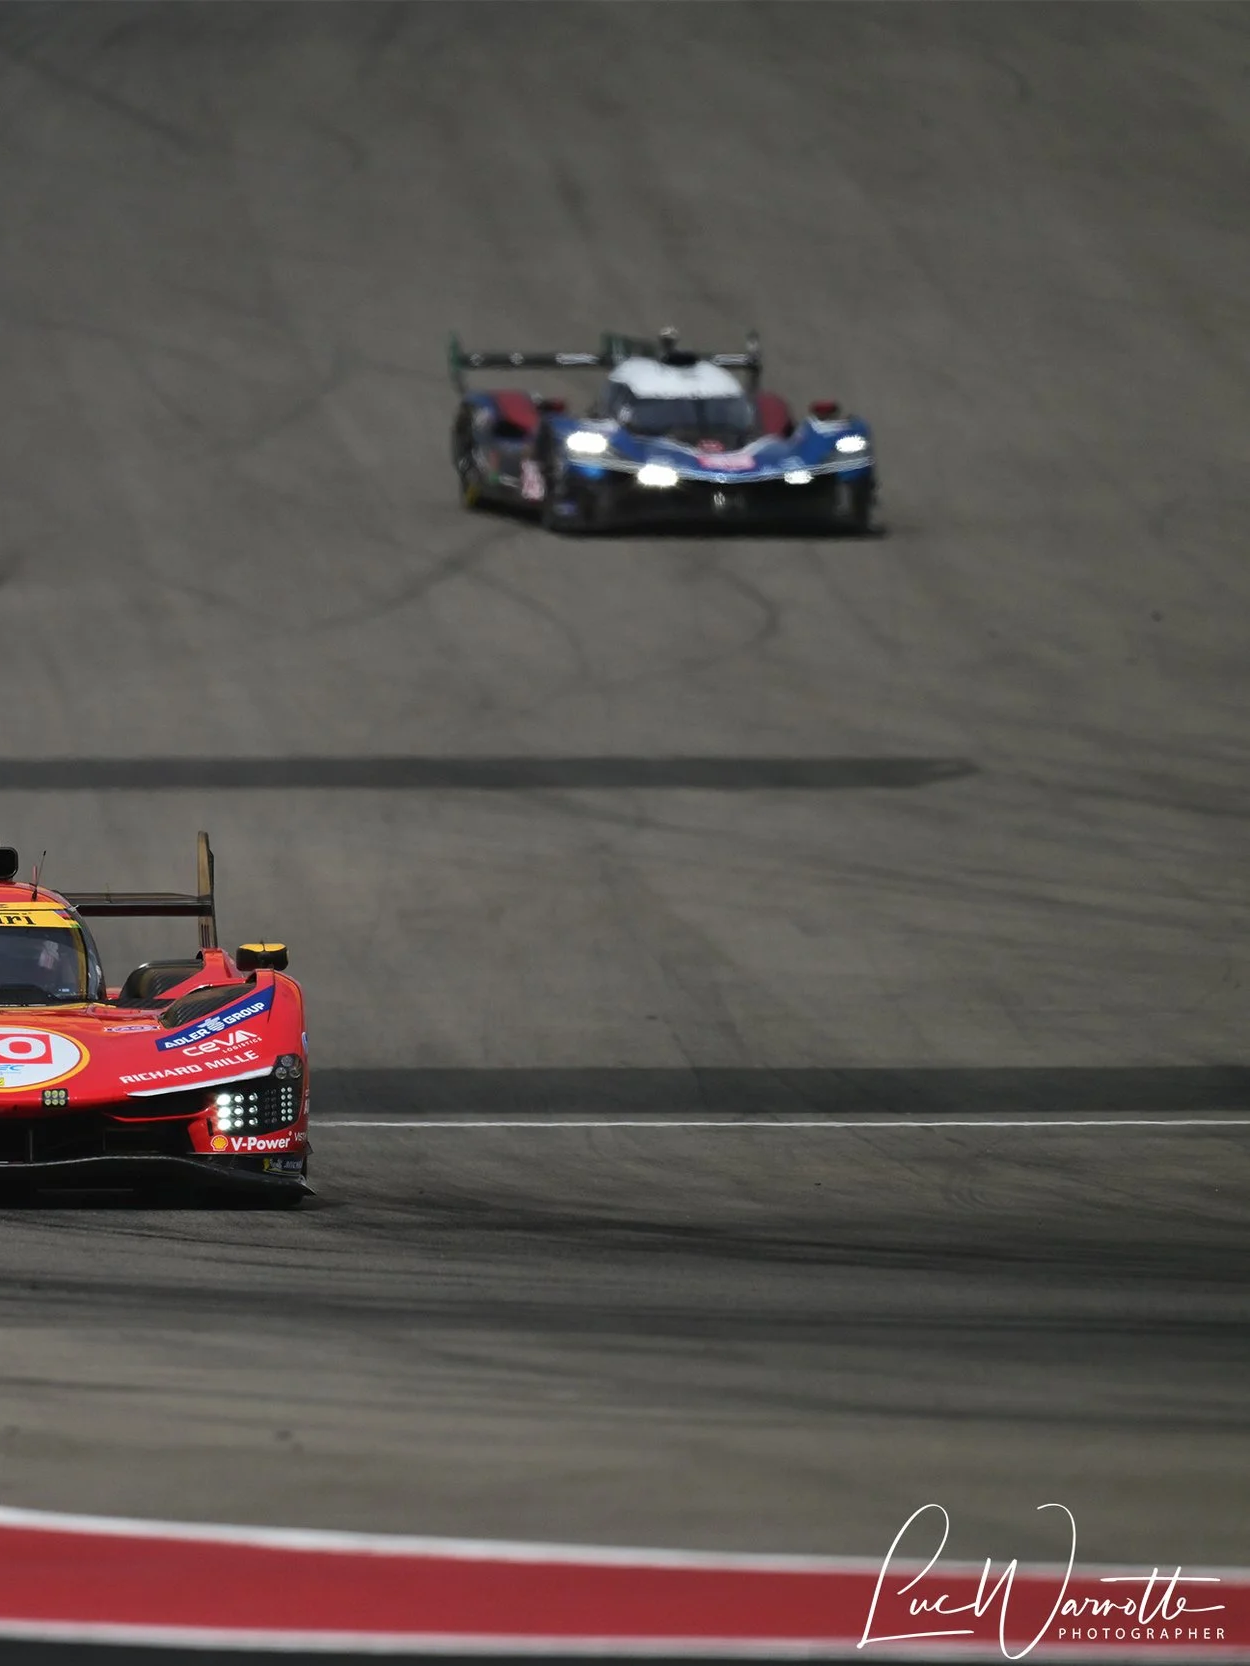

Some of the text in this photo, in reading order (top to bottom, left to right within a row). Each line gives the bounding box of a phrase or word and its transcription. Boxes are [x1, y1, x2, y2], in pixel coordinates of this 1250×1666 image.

[164, 1002, 265, 1049] ADLER GROUP
[222, 1037, 263, 1054] LOGISTICS
[119, 1050, 260, 1085] RICHARD MILLE
[231, 1136, 291, 1151] V-Power
